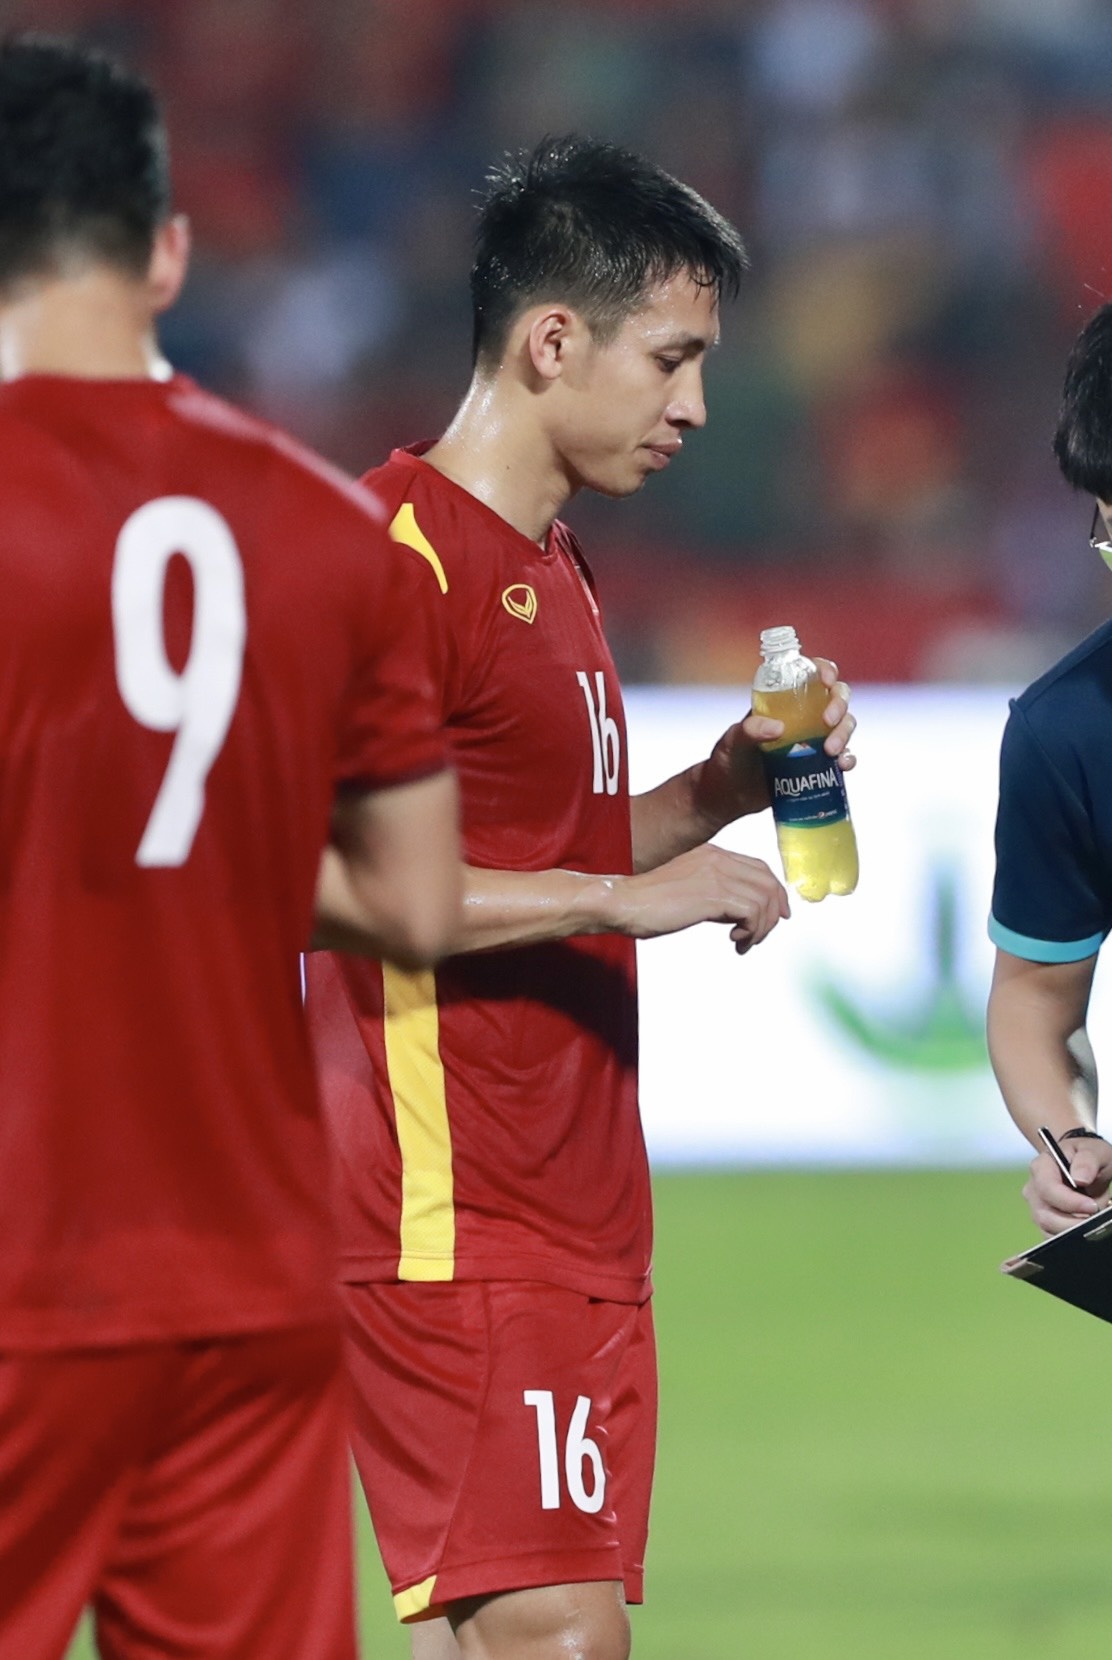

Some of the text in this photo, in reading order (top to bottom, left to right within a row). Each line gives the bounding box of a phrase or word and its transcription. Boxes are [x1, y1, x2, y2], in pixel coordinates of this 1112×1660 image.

[112, 495, 247, 869] 9
[576, 670, 621, 796] 16
[774, 767, 840, 797] AQUAFINA
[523, 1389, 607, 1514] 16
